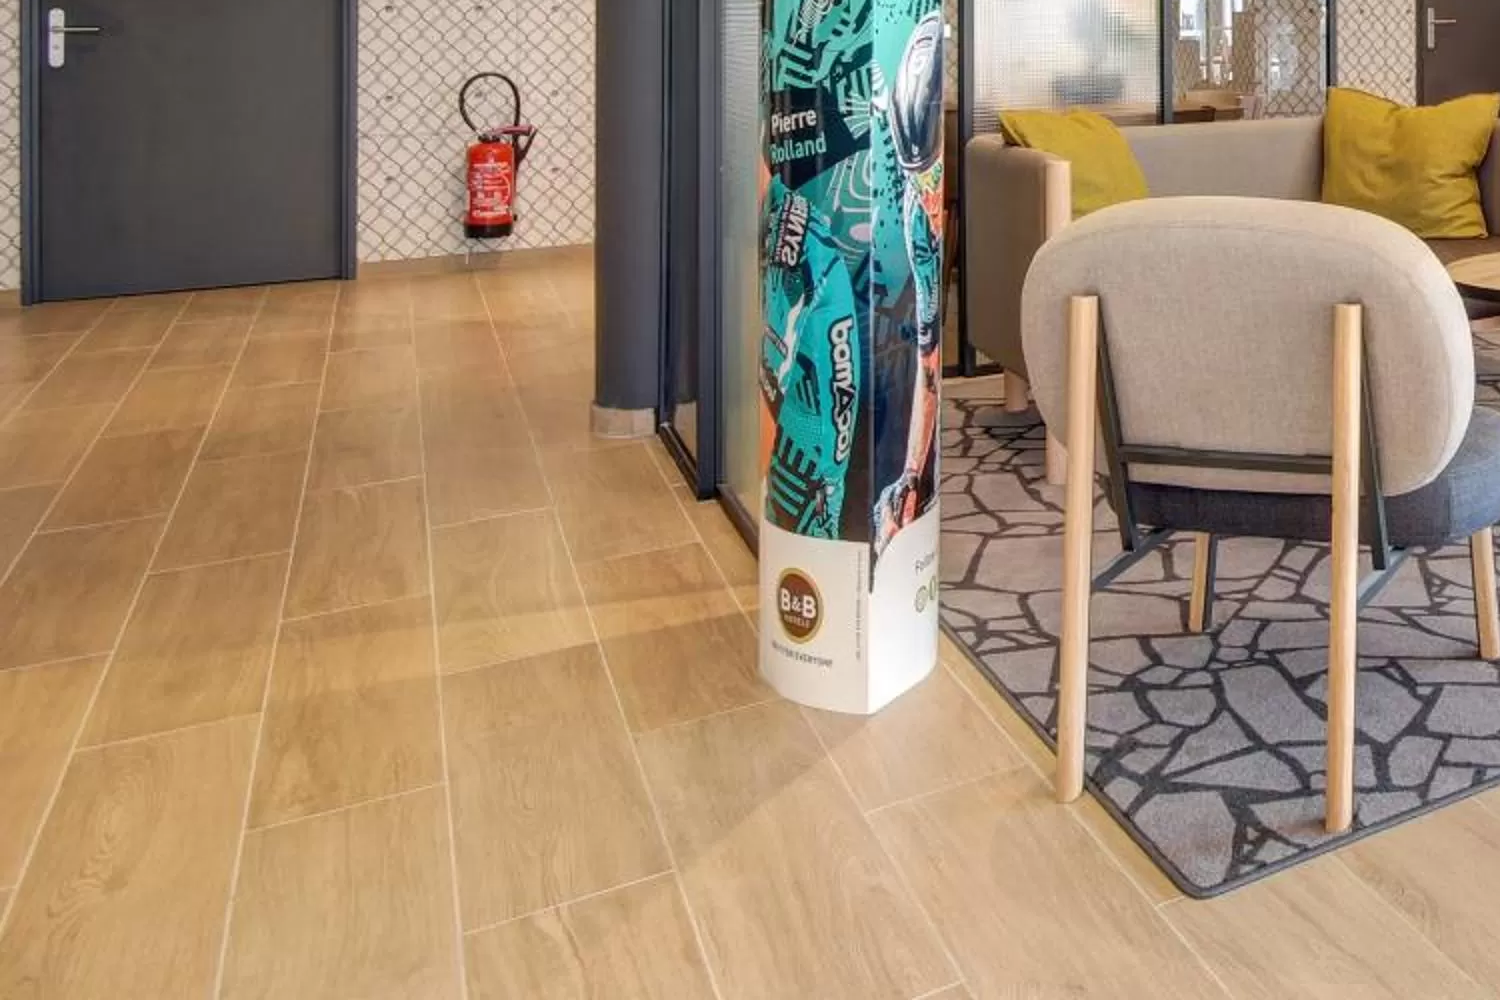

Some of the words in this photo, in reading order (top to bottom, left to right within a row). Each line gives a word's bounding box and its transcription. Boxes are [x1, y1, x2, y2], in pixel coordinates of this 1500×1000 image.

[771, 108, 817, 135] Pierre
[770, 131, 827, 165] Rolland
[780, 587, 816, 619] B&B
